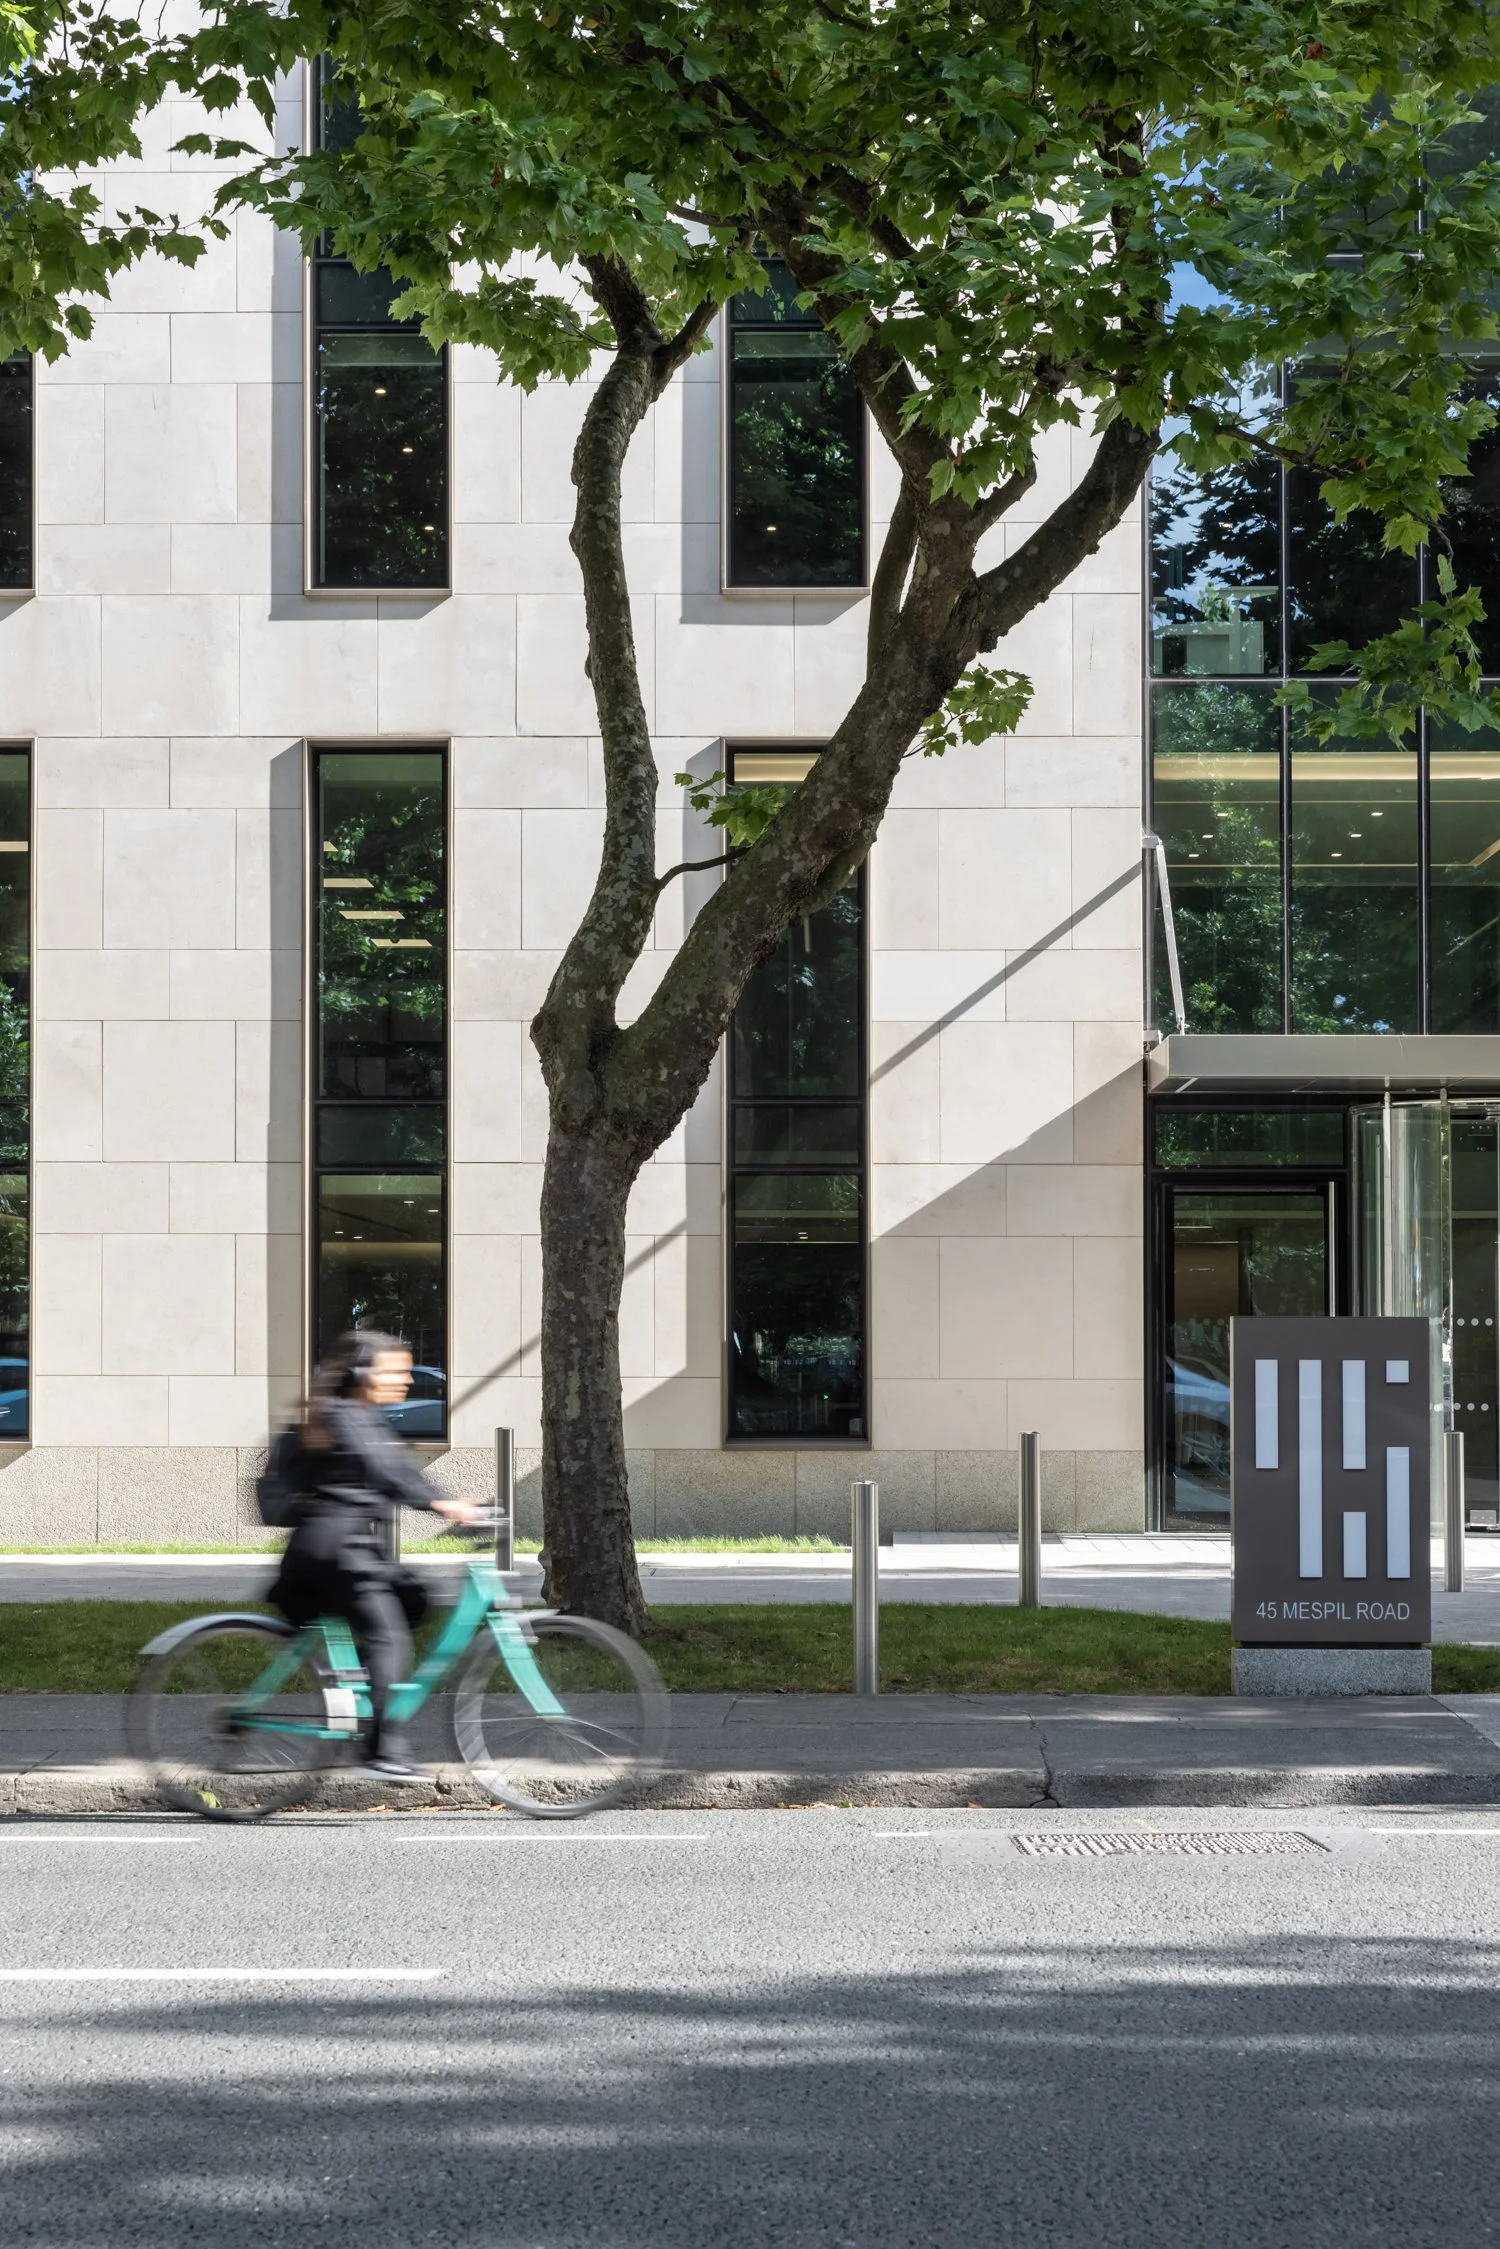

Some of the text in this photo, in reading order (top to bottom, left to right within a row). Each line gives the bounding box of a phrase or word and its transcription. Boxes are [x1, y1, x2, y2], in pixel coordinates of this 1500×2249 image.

[1256, 1602, 1410, 1620] 45 MESPIL ROAD
